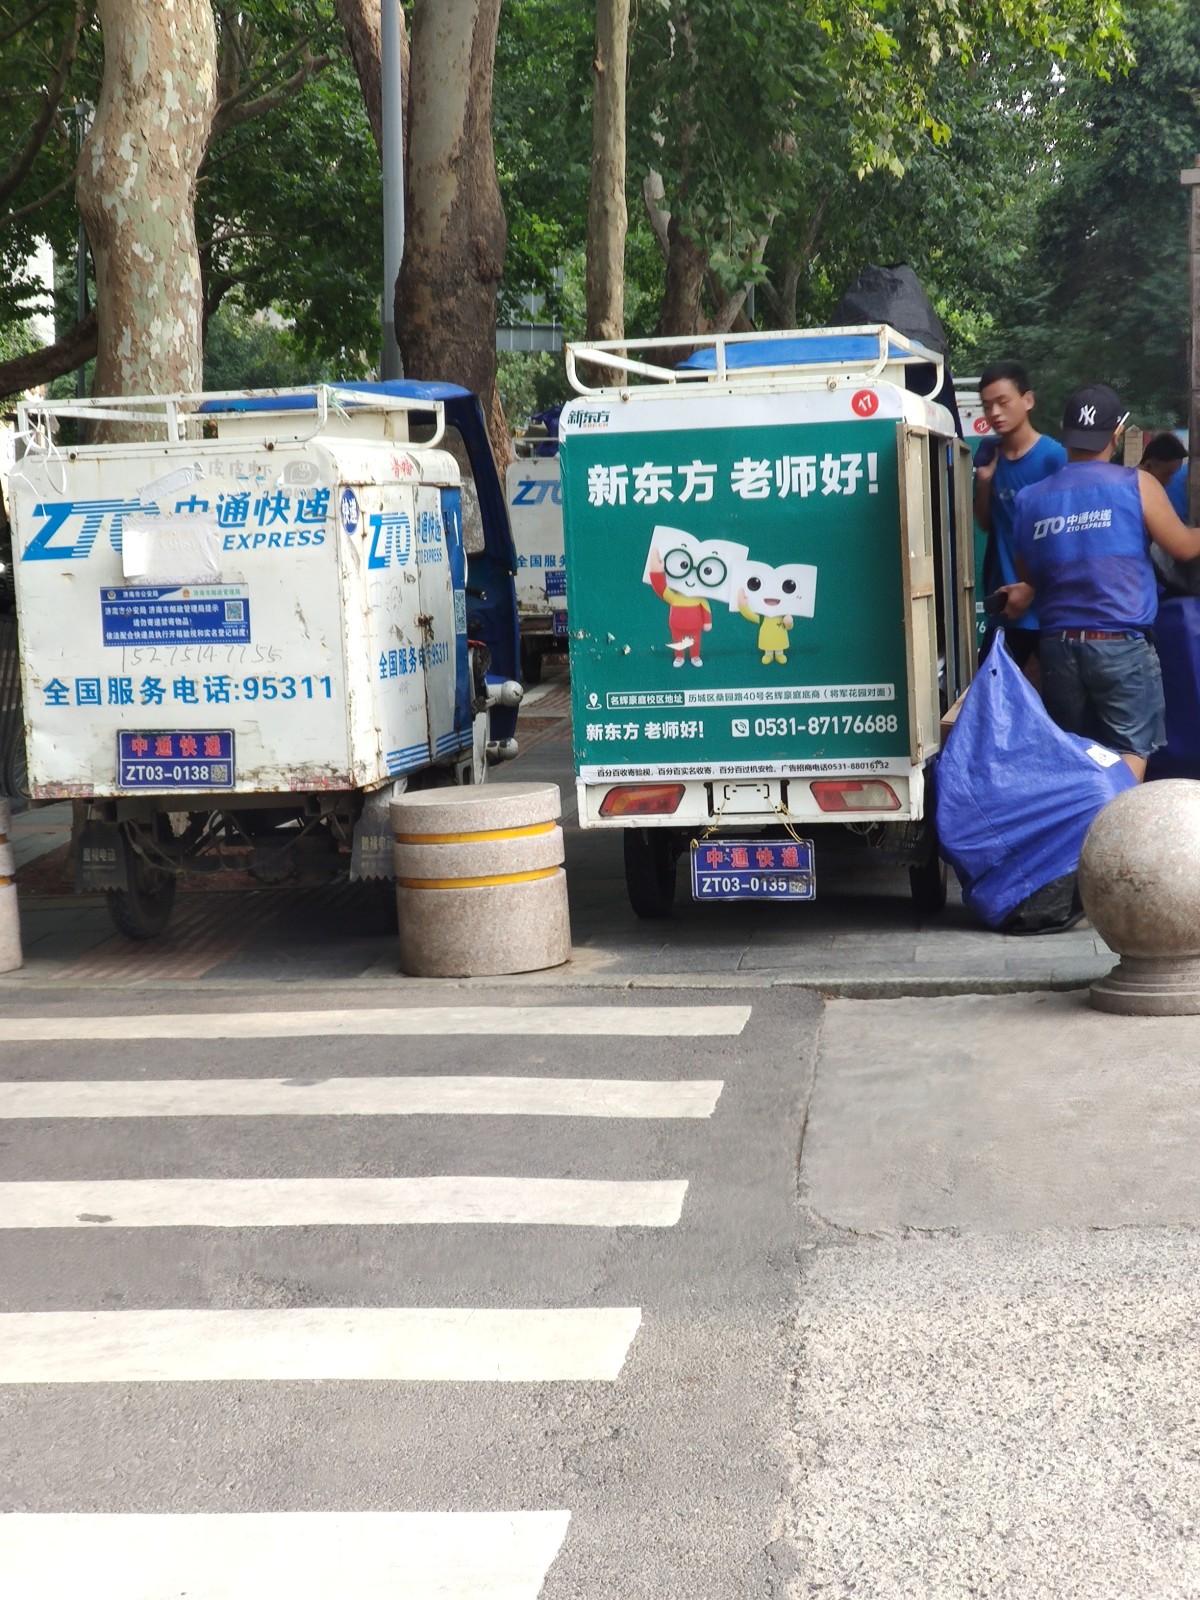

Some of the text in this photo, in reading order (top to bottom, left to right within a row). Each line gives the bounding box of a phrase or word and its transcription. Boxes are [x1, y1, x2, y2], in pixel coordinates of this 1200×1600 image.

[857, 394, 873, 411] 17
[567, 410, 611, 428] 新东方
[587, 451, 879, 506] 新东方 老师好!
[1066, 508, 1112, 526] 中通快递
[1081, 520, 1112, 530] EXPRESS
[1033, 516, 1066, 540] ZTO
[223, 529, 327, 551] EXPRESS
[42, 675, 334, 708] 全国服务电话:95311
[610, 694, 683, 706] 名辉豪庭校区地址
[586, 720, 704, 741] 新东方 老师好!
[754, 714, 898, 737] 0531-87176688
[131, 734, 222, 757] 中通快递
[126, 765, 209, 781] ZT03-0138
[706, 846, 800, 869] 中通快递
[702, 877, 787, 893] ZT03-0135
